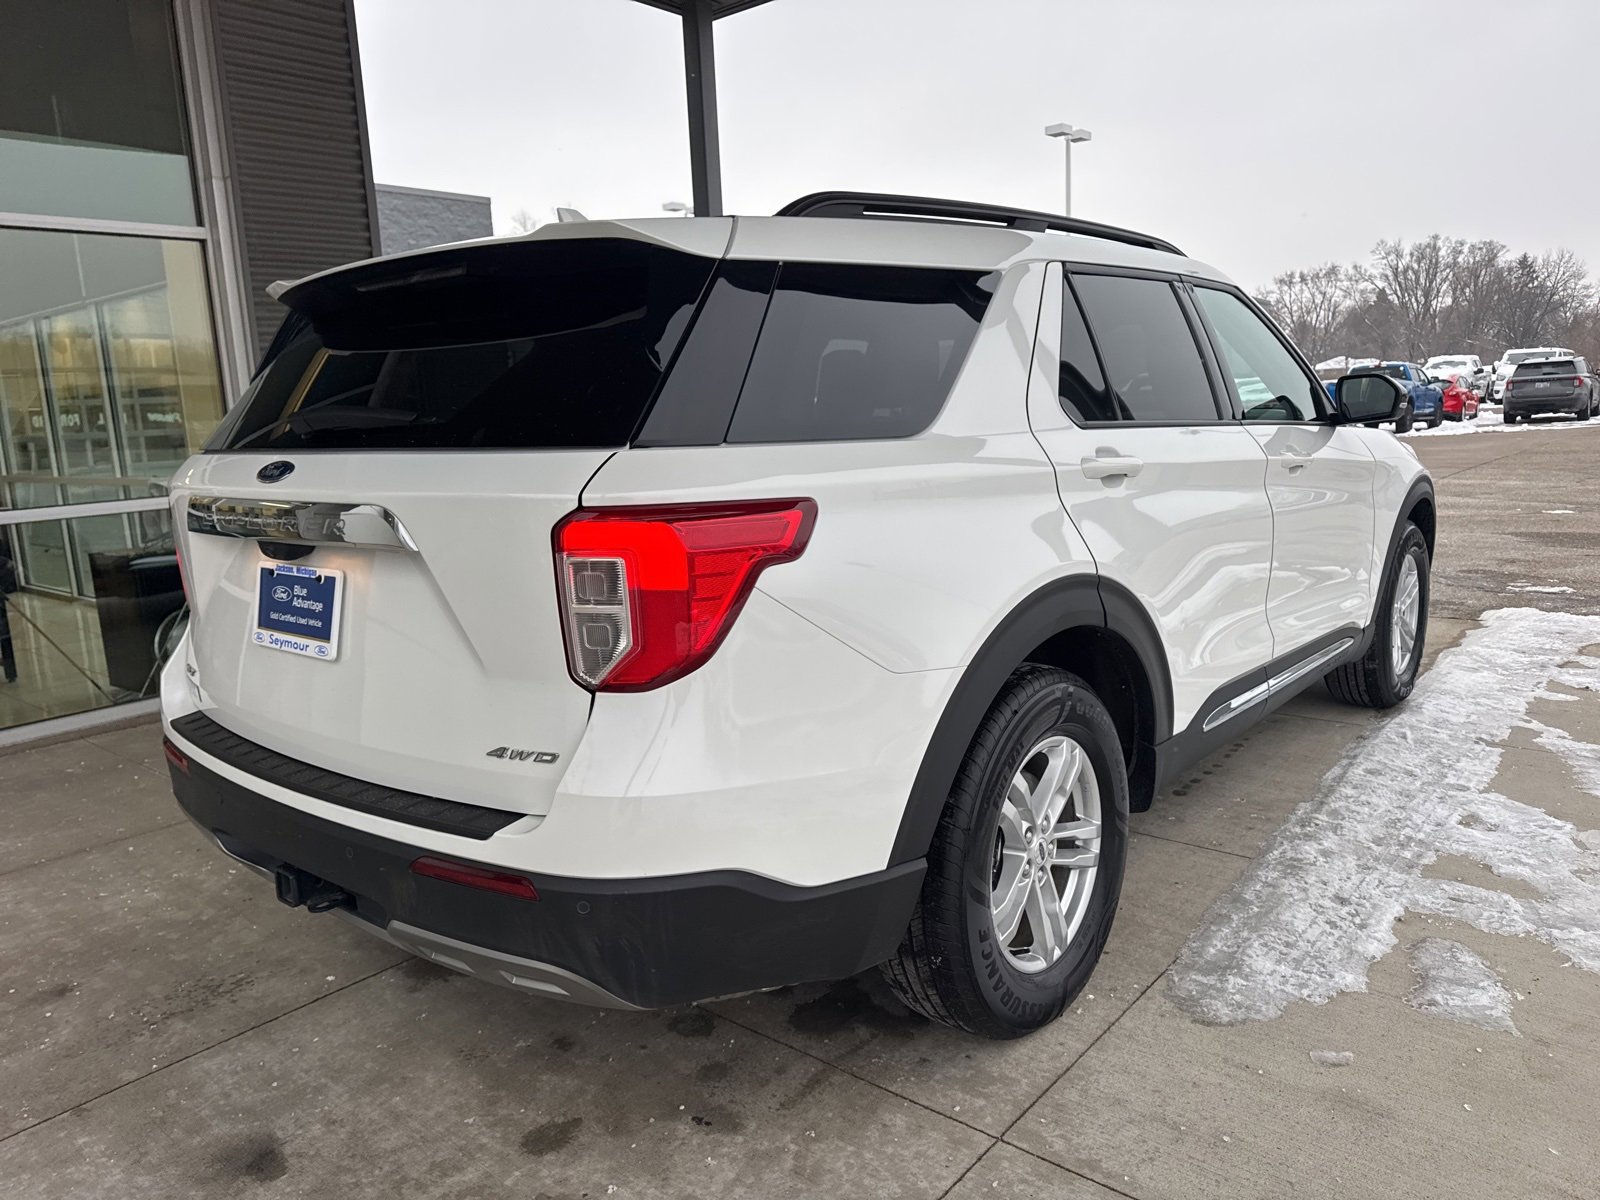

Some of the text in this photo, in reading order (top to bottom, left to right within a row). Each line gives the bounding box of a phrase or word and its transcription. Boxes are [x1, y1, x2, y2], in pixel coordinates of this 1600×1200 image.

[203, 512, 346, 535] EXPLORER
[293, 585, 307, 596] Blue
[292, 597, 323, 612] Advantage
[270, 611, 322, 628] Gold Certified Used Vehicle
[269, 633, 309, 652] Seymour
[486, 746, 560, 764] 4WD
